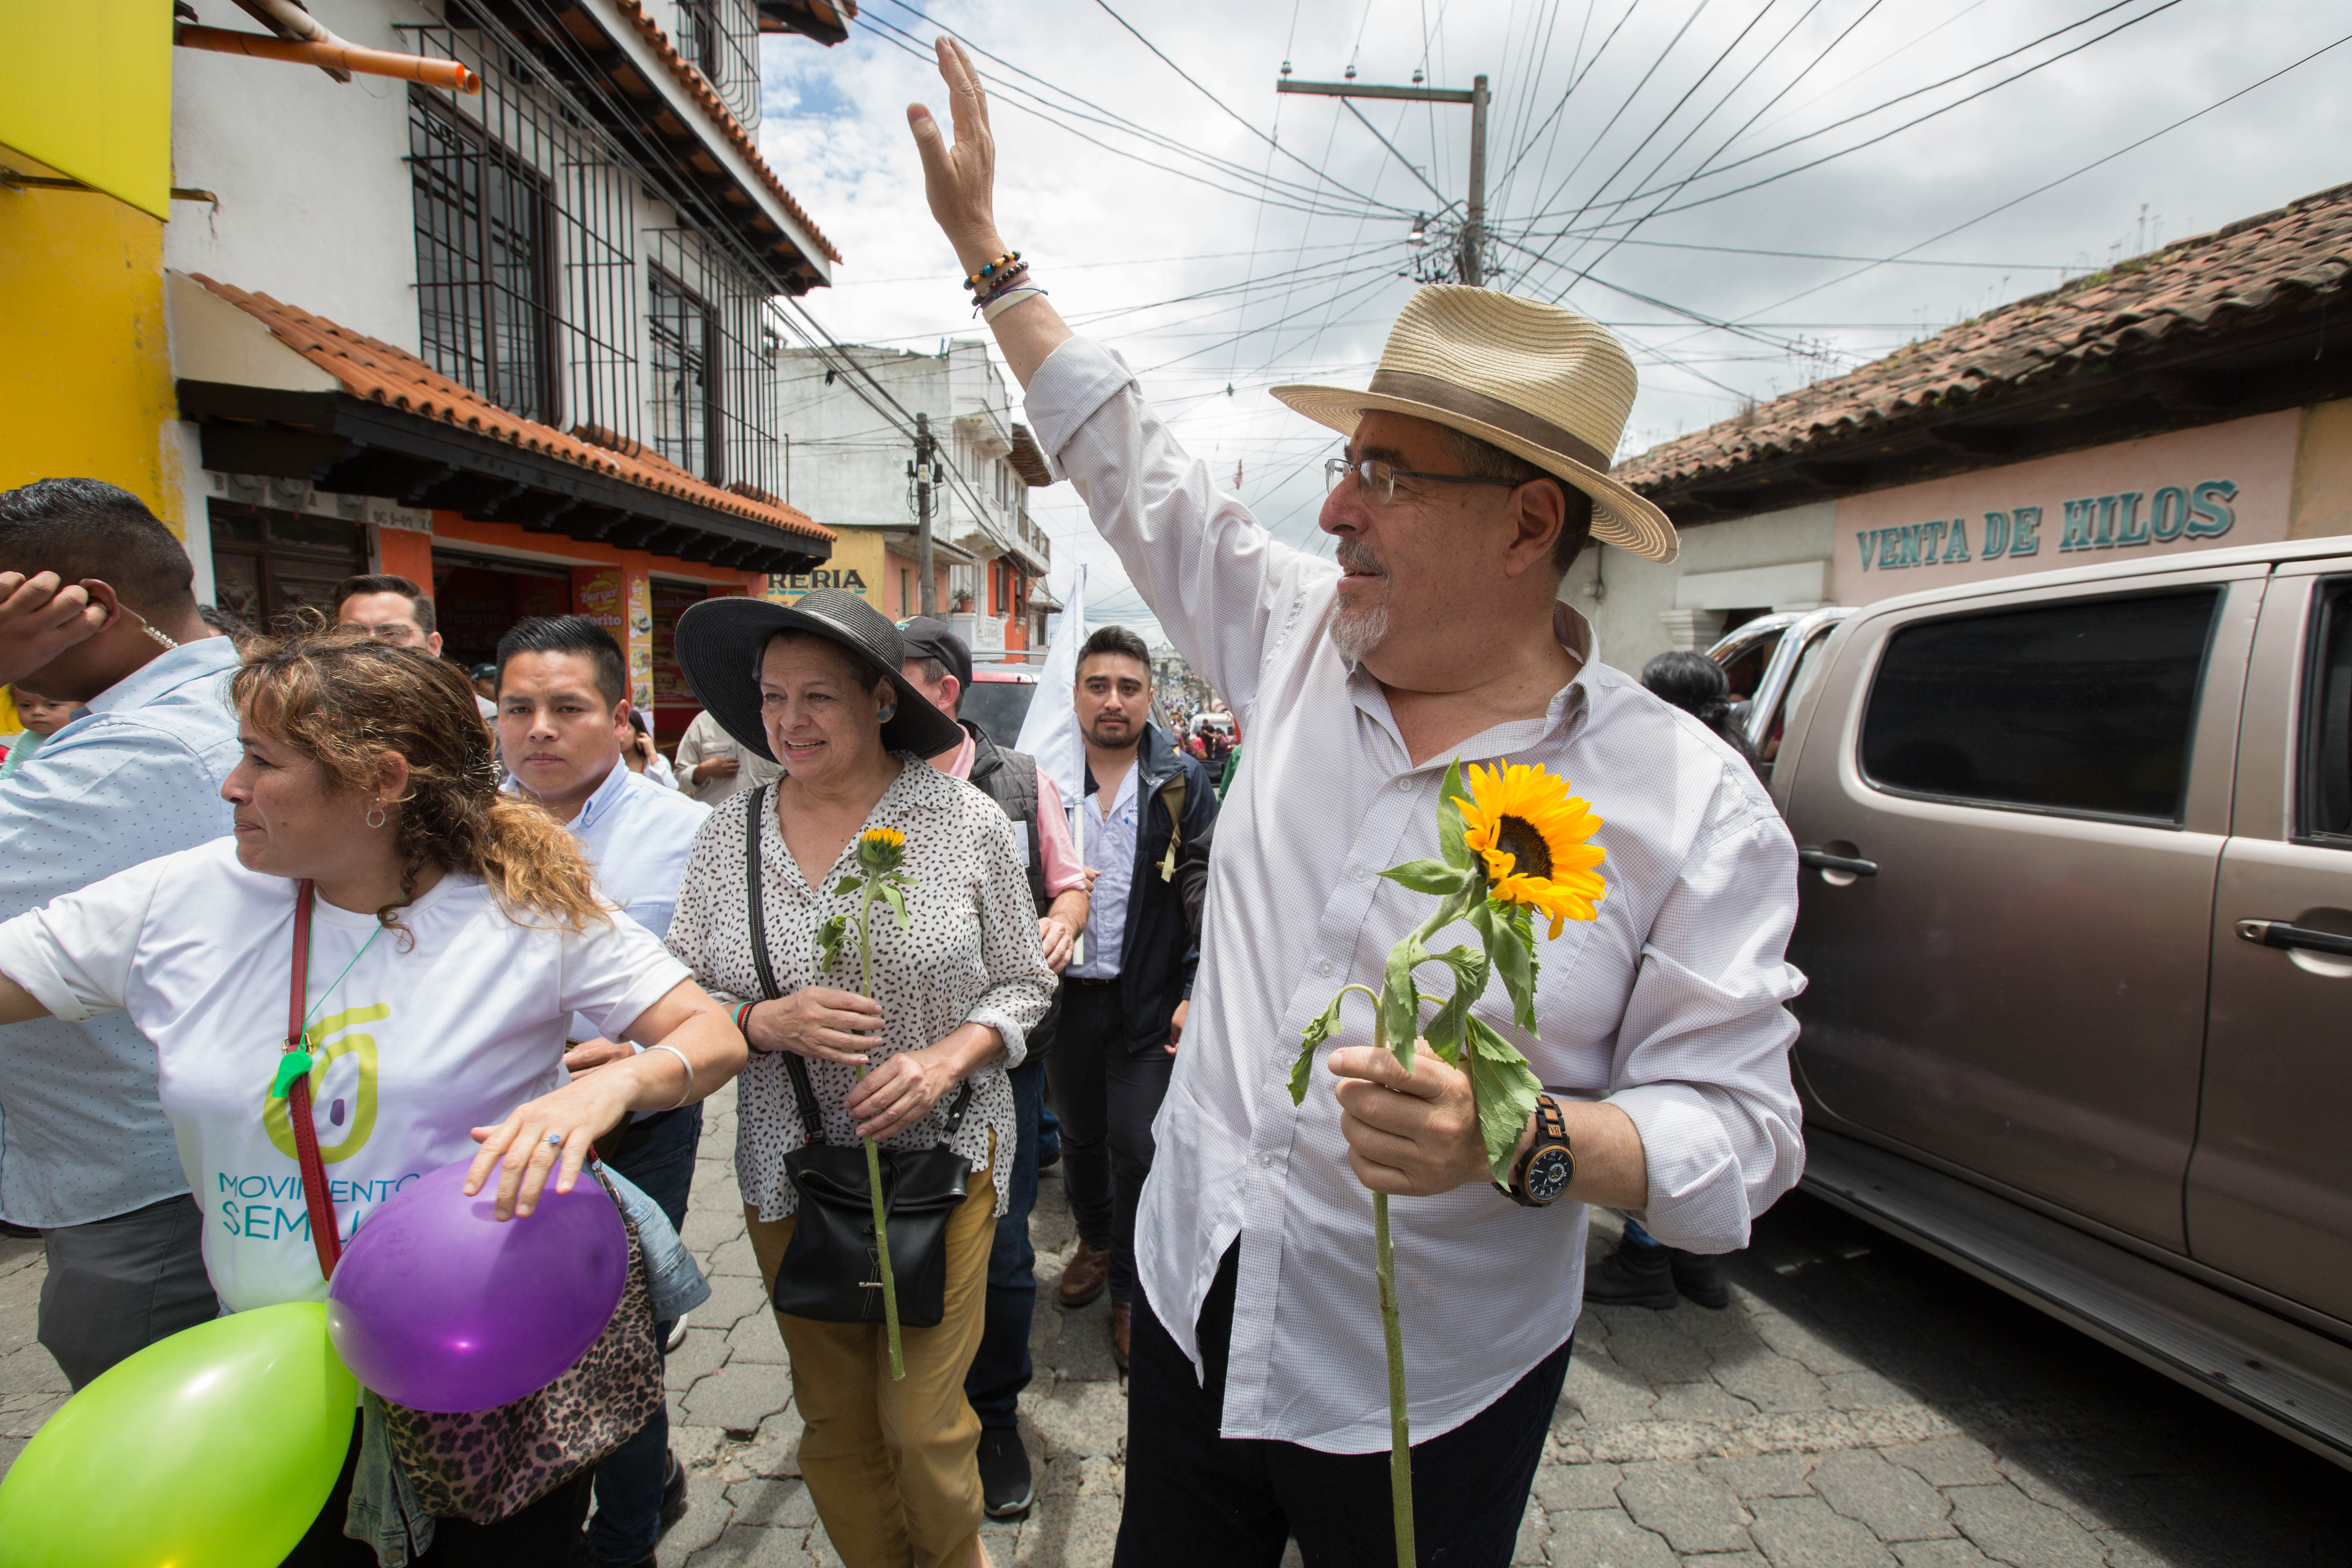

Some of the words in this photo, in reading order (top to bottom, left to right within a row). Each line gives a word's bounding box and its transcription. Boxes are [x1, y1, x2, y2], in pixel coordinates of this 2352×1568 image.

[1856, 517, 1971, 572] VENTA
[1981, 506, 2042, 561] DE
[2058, 479, 2239, 553] HILOS
[1549, 1125, 1560, 1135] BA
[218, 1172, 421, 1203] MOVIENT
